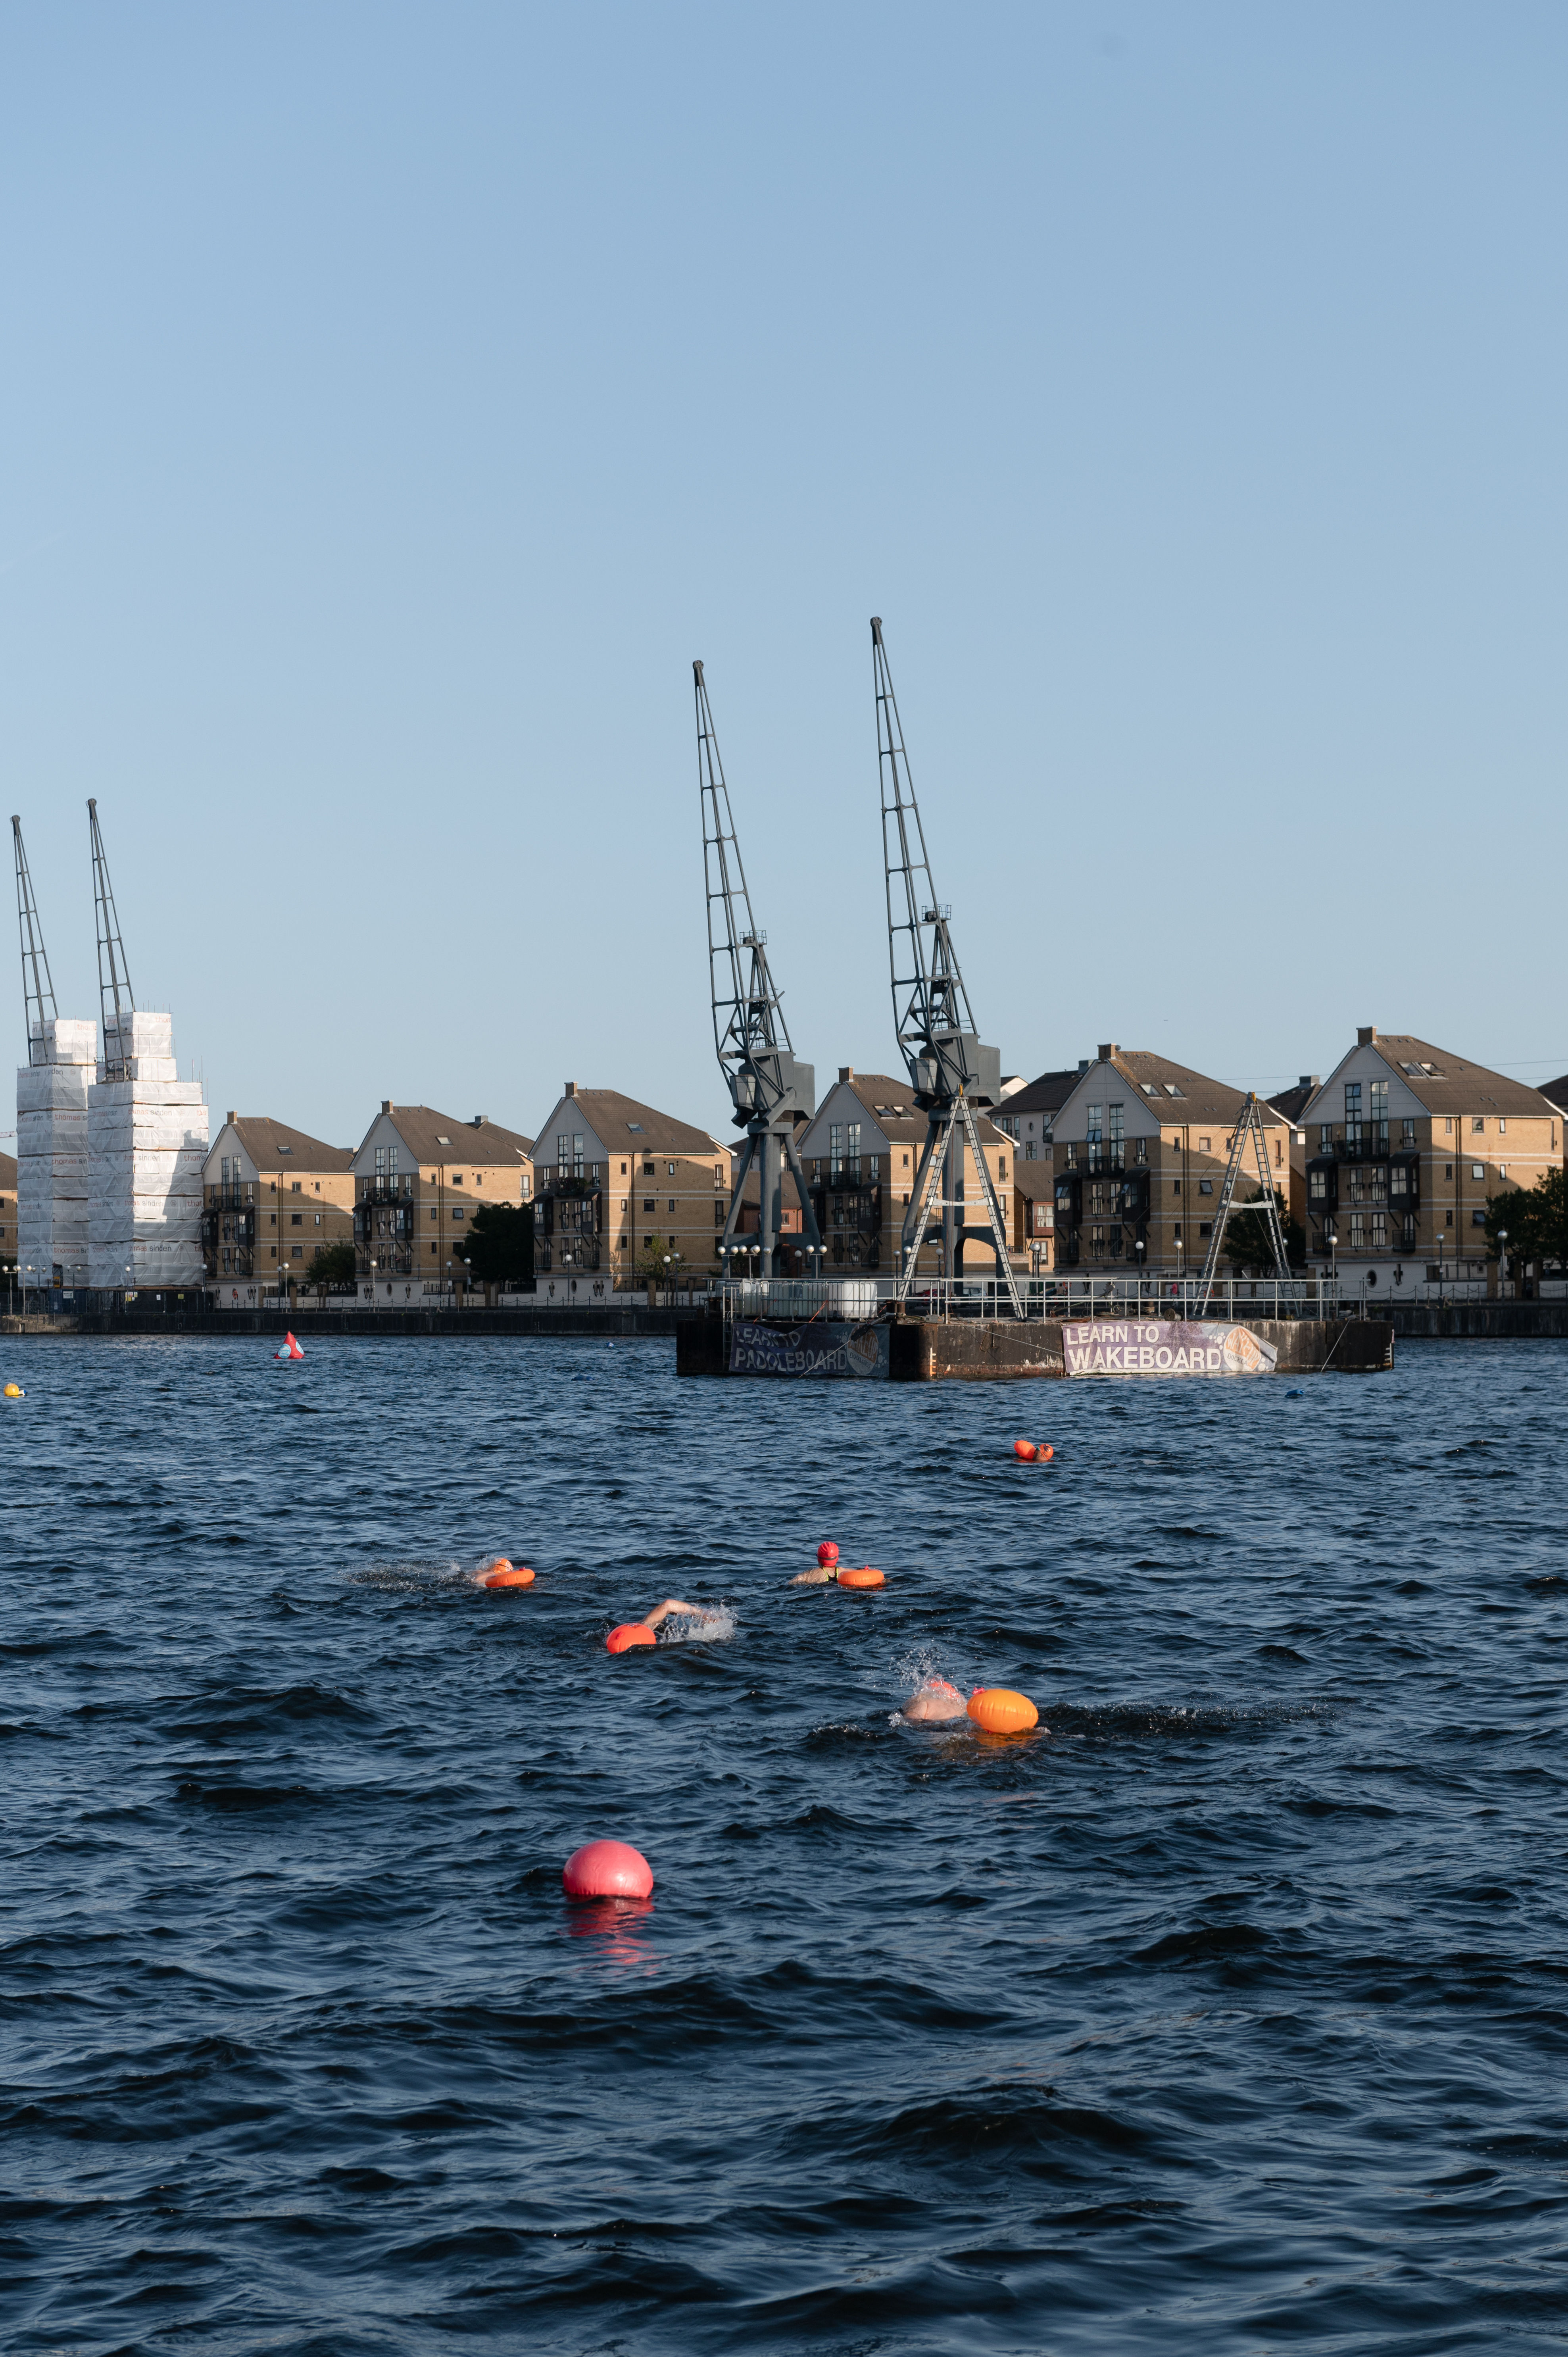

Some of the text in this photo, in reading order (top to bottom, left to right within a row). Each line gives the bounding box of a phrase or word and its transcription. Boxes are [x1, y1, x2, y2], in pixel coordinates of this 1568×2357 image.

[1066, 1325, 1159, 1345] LEARN TO
[734, 1348, 847, 1372] PADDLEBOARD
[1068, 1346, 1222, 1371] WAKEBOARD
